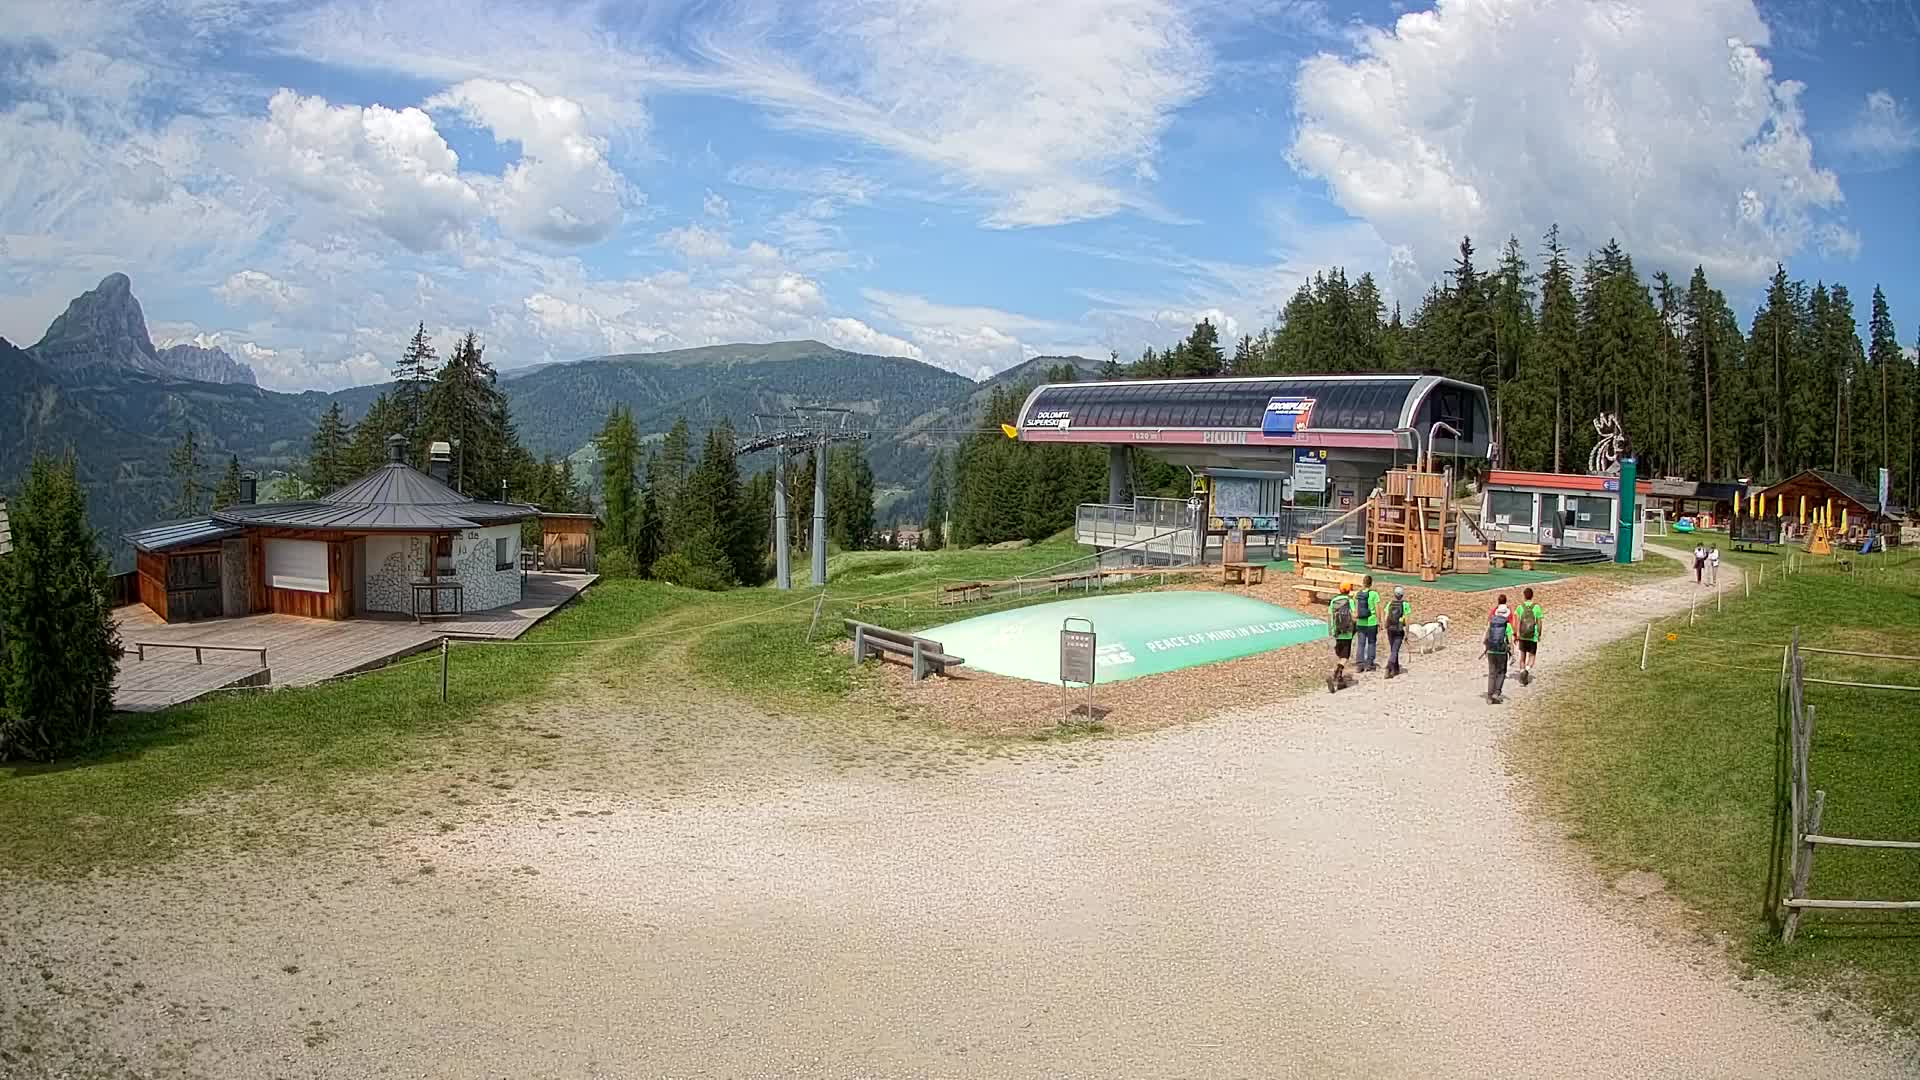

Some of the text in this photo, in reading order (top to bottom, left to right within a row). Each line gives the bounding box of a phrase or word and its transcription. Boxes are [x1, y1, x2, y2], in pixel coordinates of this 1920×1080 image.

[1203, 431, 1246, 444] PICULIN
[1145, 636, 1189, 652] PEACE
[1188, 633, 1205, 644] OF
[1205, 629, 1236, 641] MIND
[1236, 627, 1250, 637] IN
[1248, 624, 1271, 634] ALL
